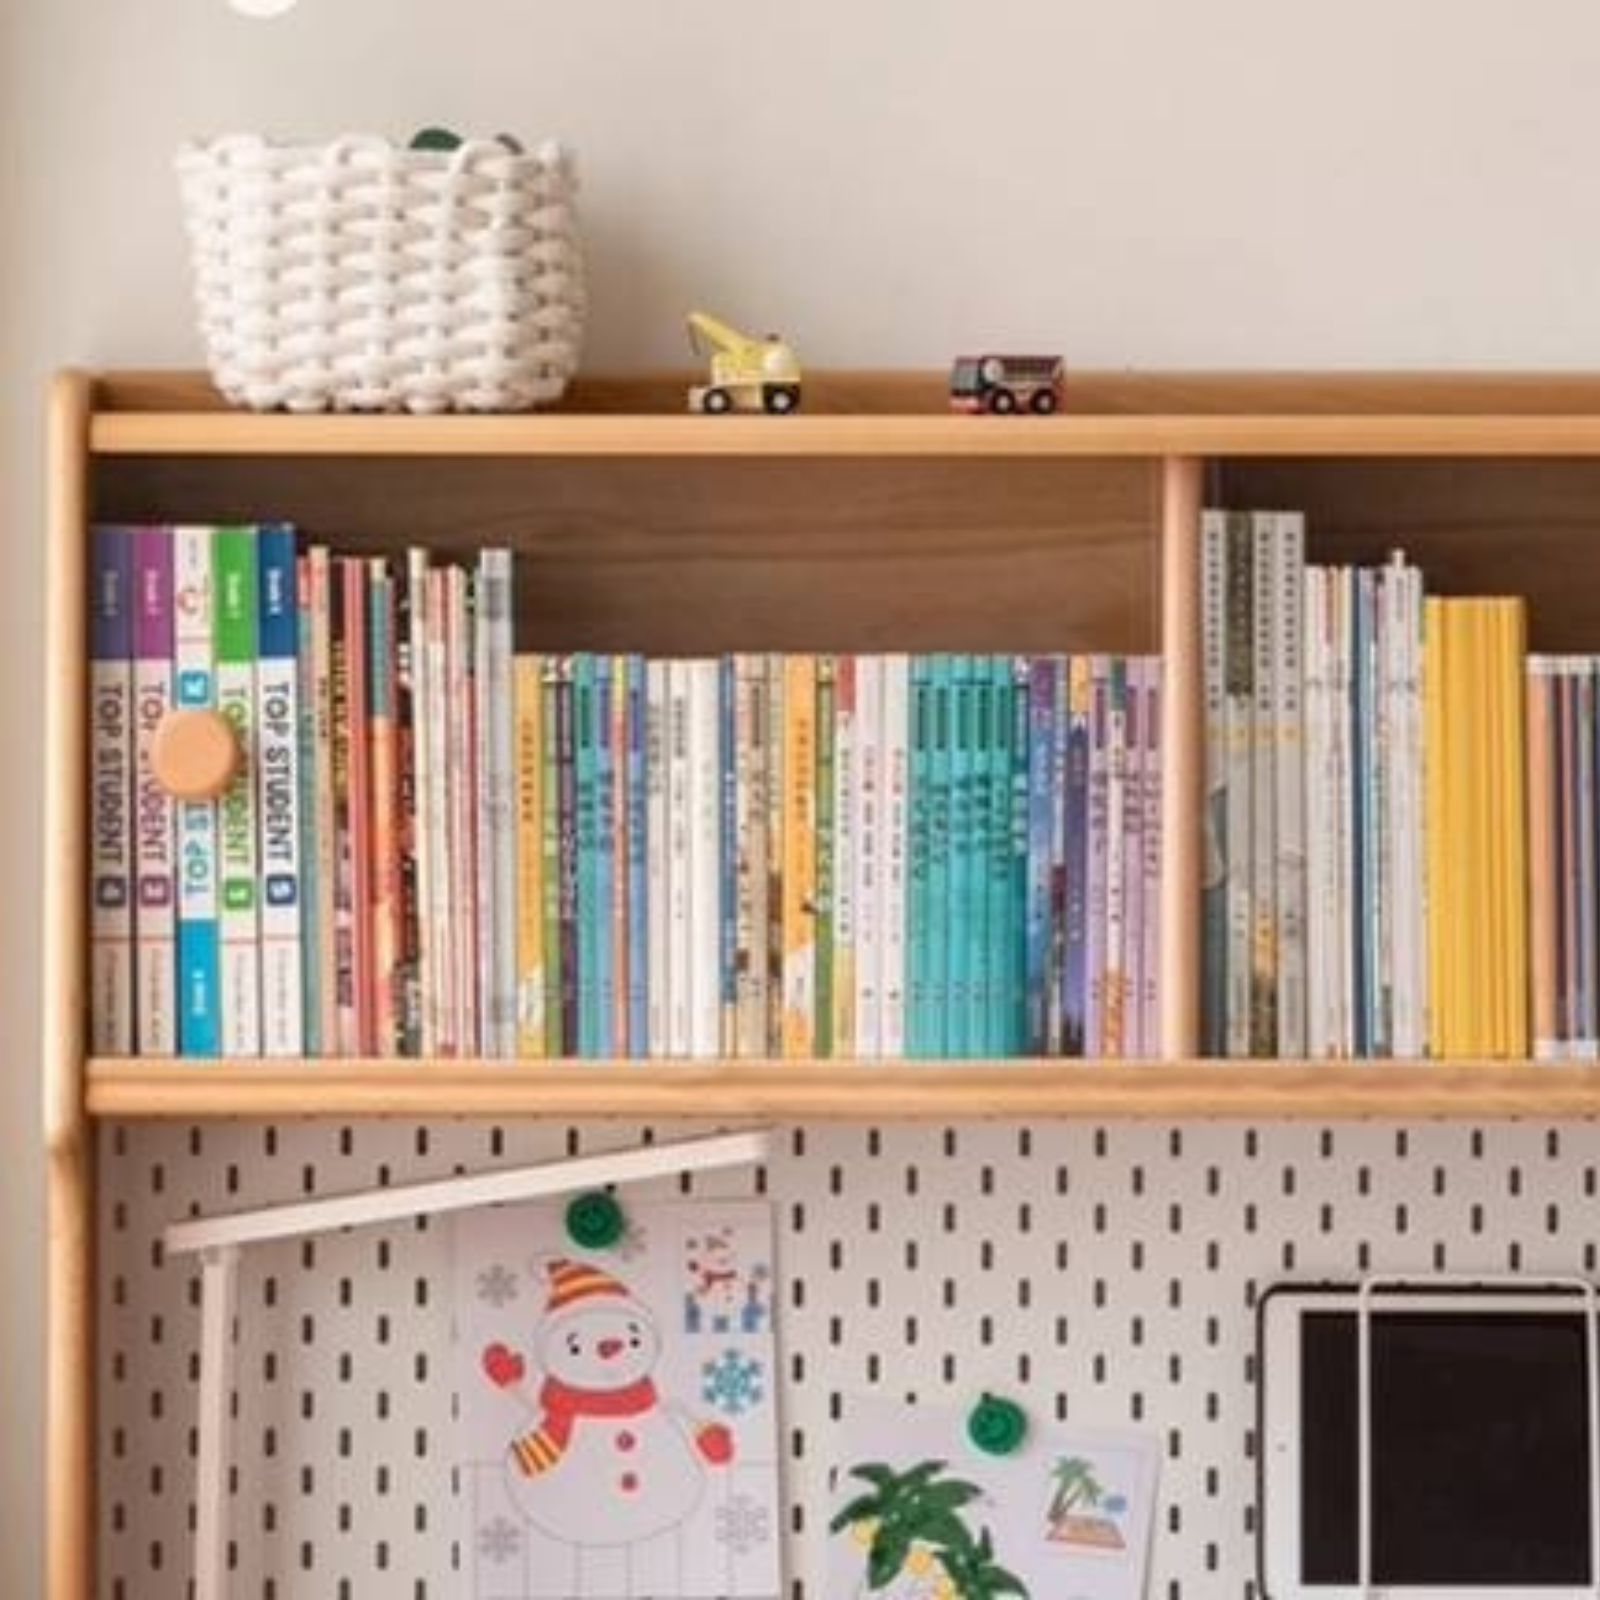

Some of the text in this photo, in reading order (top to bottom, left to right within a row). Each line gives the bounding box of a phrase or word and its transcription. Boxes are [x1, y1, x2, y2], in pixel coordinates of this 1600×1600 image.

[99, 682, 122, 738] TOP
[265, 682, 290, 736] TOP
[99, 748, 122, 867] STUDENT
[265, 748, 292, 864] STUDENT
[184, 840, 209, 893] TOP
